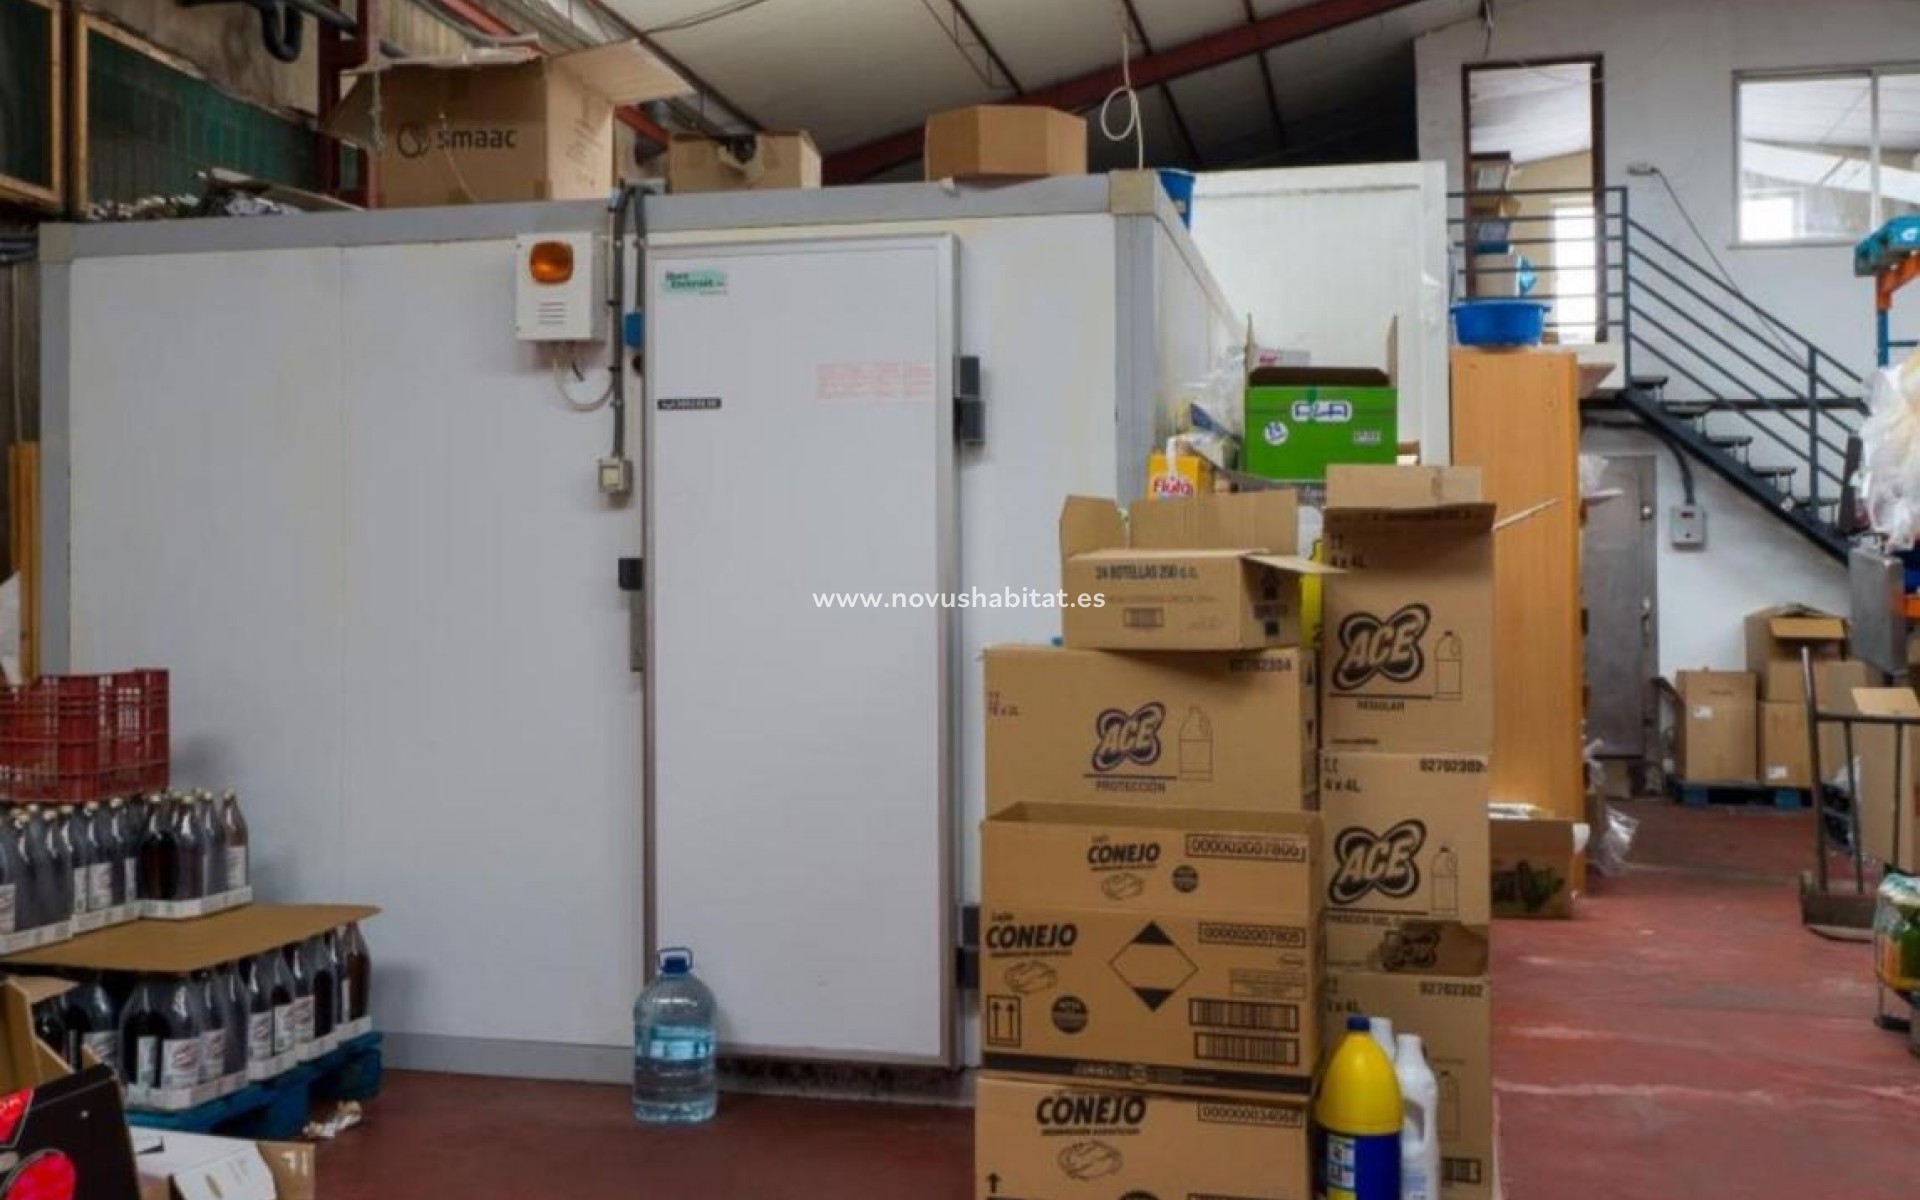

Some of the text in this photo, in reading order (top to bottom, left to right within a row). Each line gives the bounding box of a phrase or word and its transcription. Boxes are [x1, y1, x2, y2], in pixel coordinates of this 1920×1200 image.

[436, 129, 517, 149] smaac
[1087, 842, 1160, 864] CONEJO
[985, 924, 1078, 949] CONEJO
[1036, 1095, 1147, 1125] CONEJO
